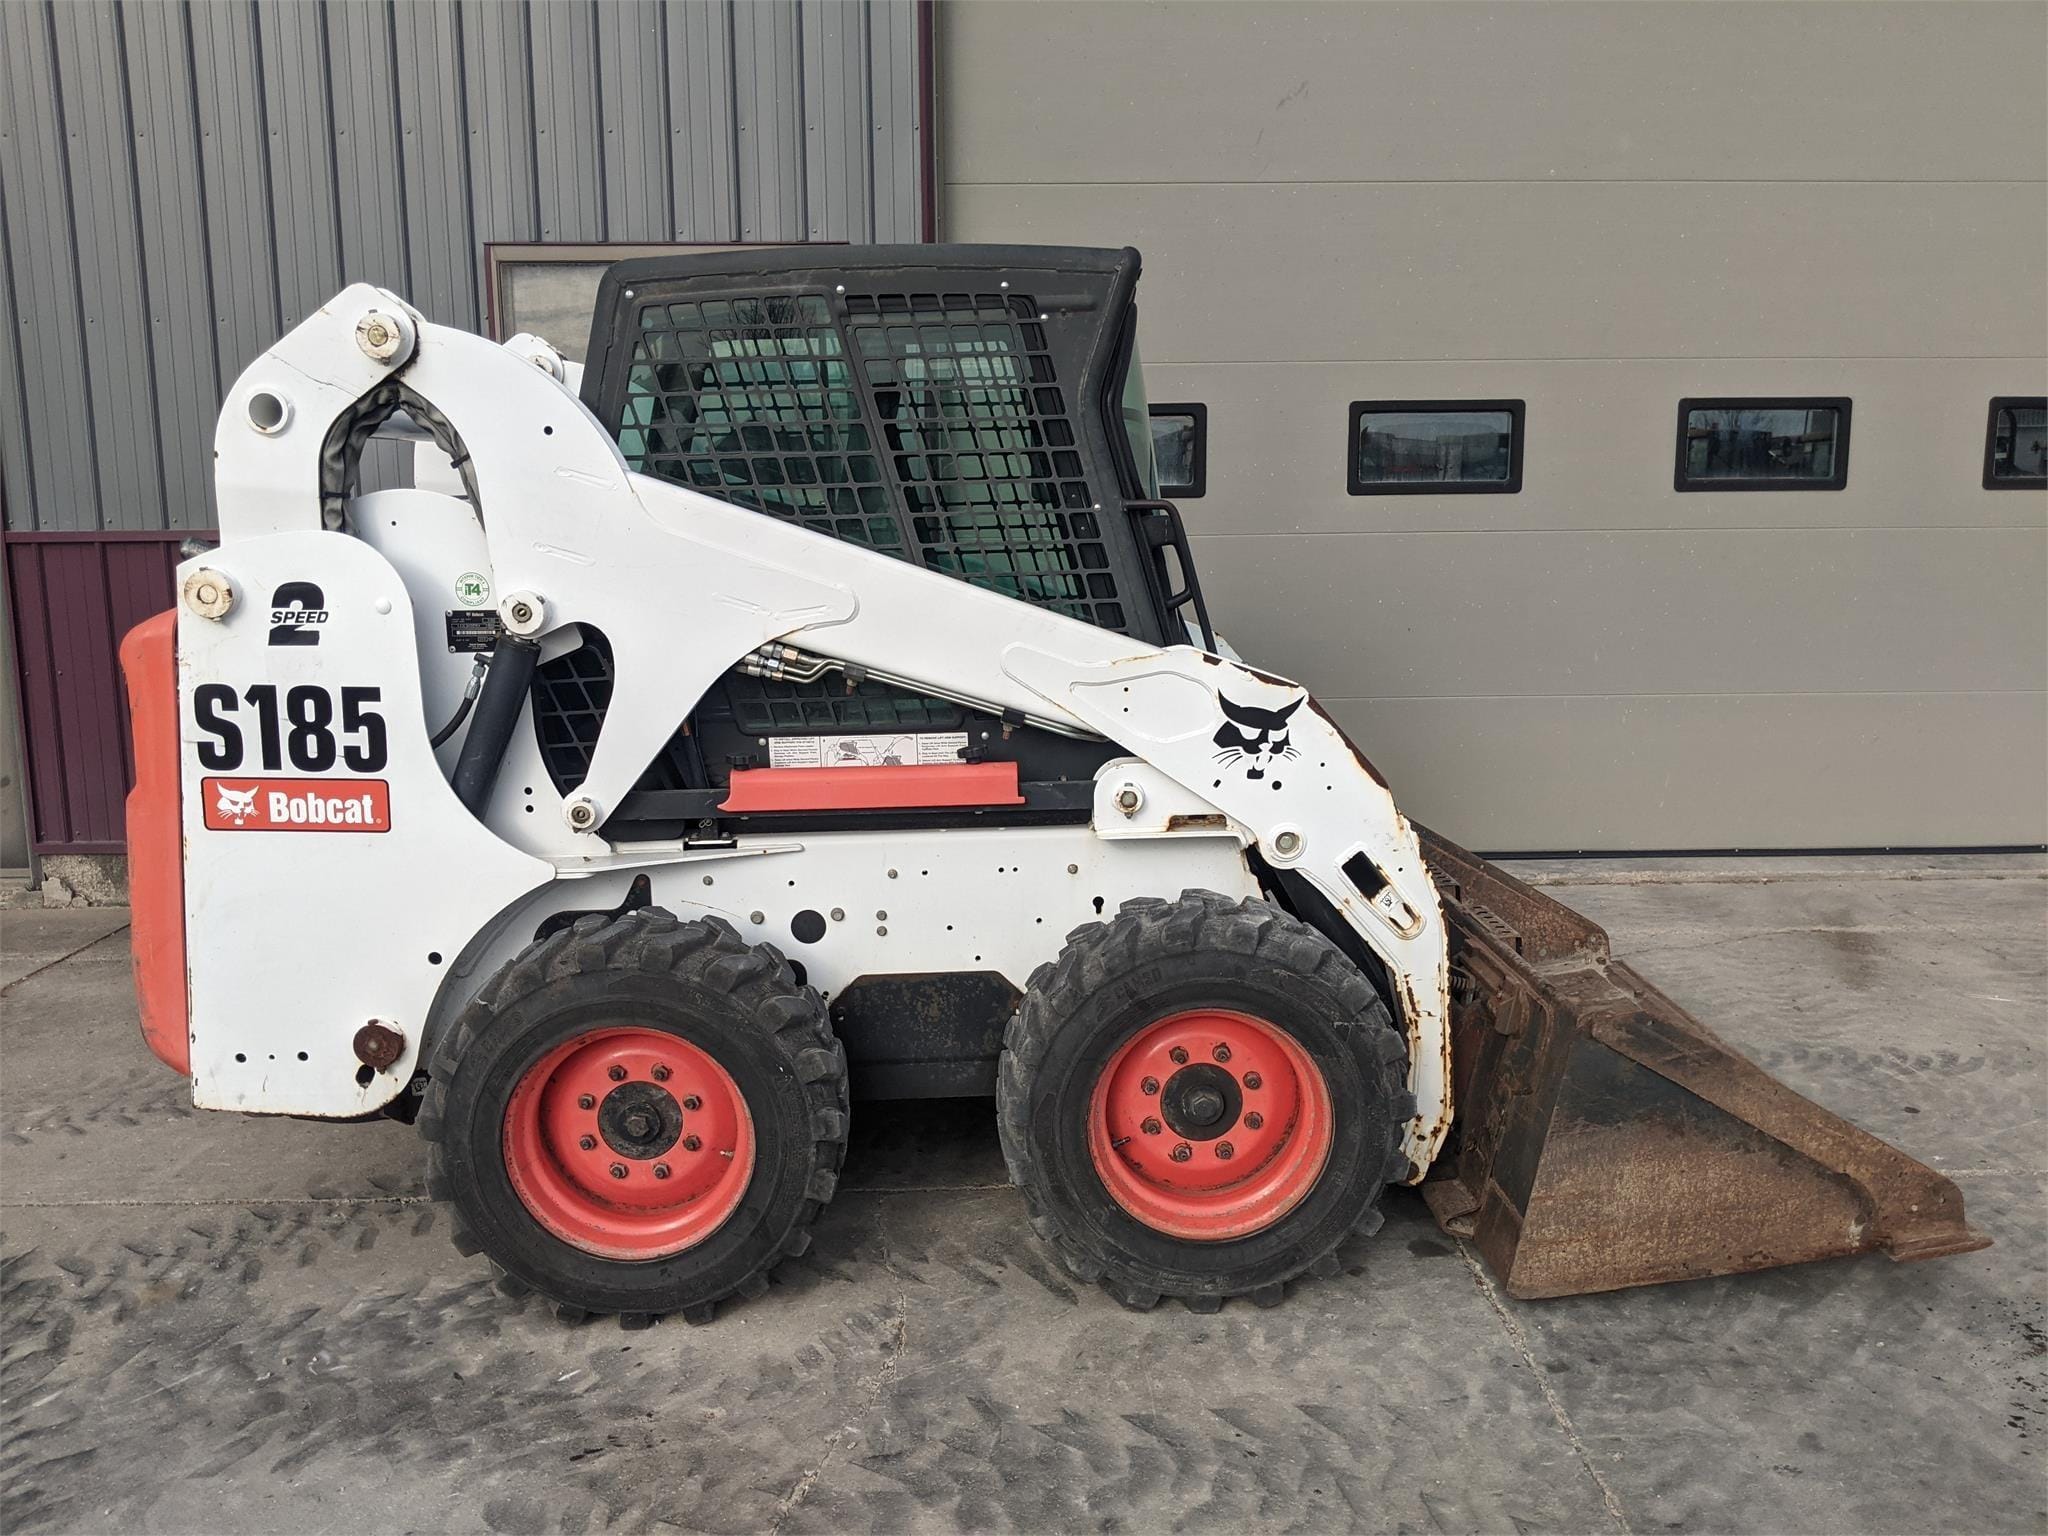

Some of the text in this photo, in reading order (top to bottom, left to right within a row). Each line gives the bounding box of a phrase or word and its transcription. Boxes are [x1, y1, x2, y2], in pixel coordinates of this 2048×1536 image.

[267, 581, 325, 646] 2
[270, 611, 329, 624] SPEED
[193, 683, 388, 773] S185
[268, 784, 375, 825] Bobcat
